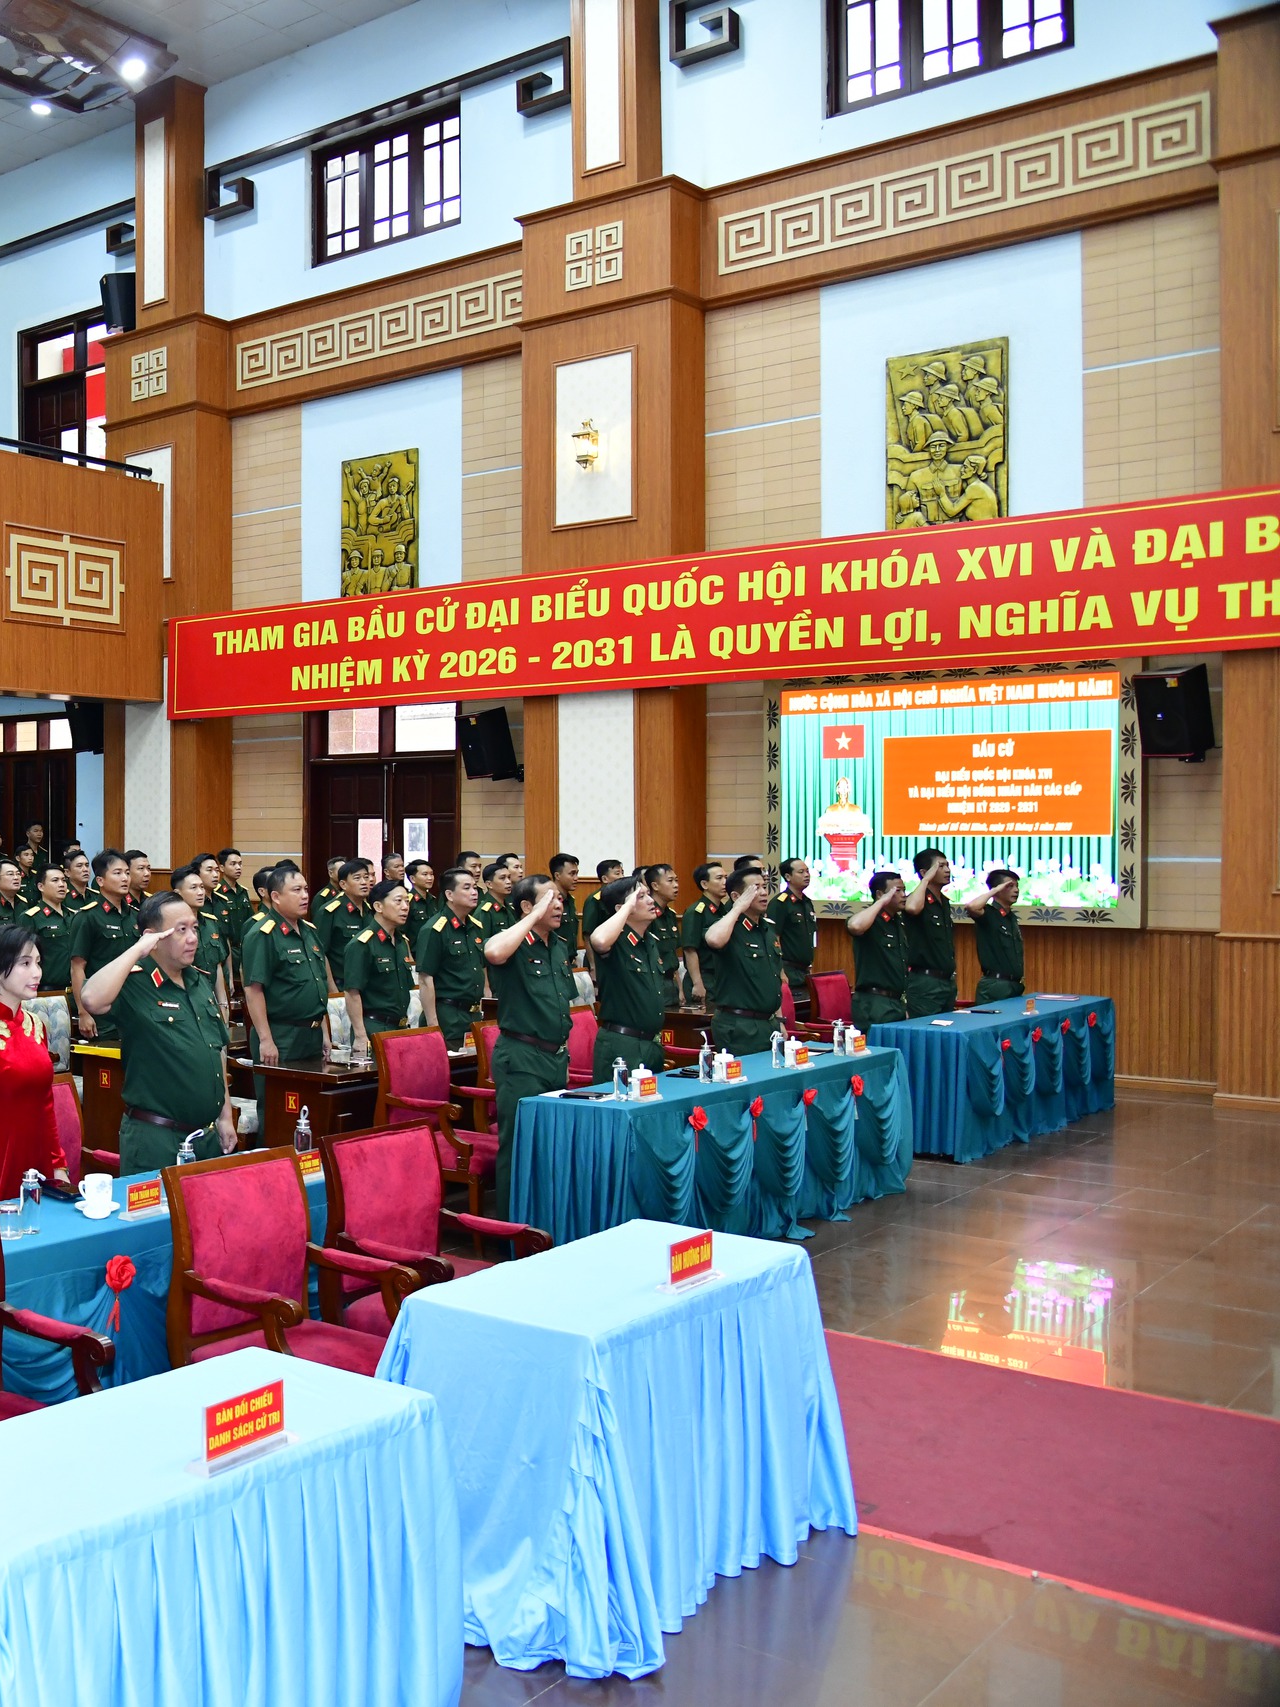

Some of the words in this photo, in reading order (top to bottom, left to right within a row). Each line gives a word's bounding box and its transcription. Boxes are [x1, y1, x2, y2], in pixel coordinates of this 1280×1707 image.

[213, 625, 284, 655] THAM
[294, 620, 338, 647] GIA
[348, 605, 405, 642] BẦU
[416, 597, 459, 634] CỬ
[465, 597, 520, 629] ĐẠI
[532, 579, 610, 623] BIỂU
[648, 567, 724, 616] QUỐC
[738, 562, 806, 607] HỘI
[822, 549, 940, 594] KHÓA
[956, 542, 1033, 581] XVI
[1050, 527, 1116, 572] VÀ
[1132, 521, 1224, 569] ĐẠI
[291, 656, 382, 693] NHIỆM
[393, 646, 430, 682] KỲ
[440, 647, 517, 678] 2026
[528, 656, 541, 664] -
[552, 636, 633, 670] 2031
[651, 624, 695, 662] LÀ
[709, 609, 844, 660] QUYỀN
[860, 608, 941, 652] LỢI,
[959, 590, 1113, 640] NGHĨA
[1130, 587, 1199, 626] VỤ
[664, 1032, 671, 1043] N
[101, 1072, 109, 1085] R
[288, 1095, 296, 1109] K
[216, 1408, 233, 1426] BÀN
[235, 1398, 248, 1419] ĐỐI
[250, 1390, 273, 1412] CHIẾU
[208, 1430, 231, 1451] DANH
[233, 1423, 254, 1440] SÁCH
[255, 1412, 267, 1431] CỬ
[268, 1410, 280, 1426] TRI
